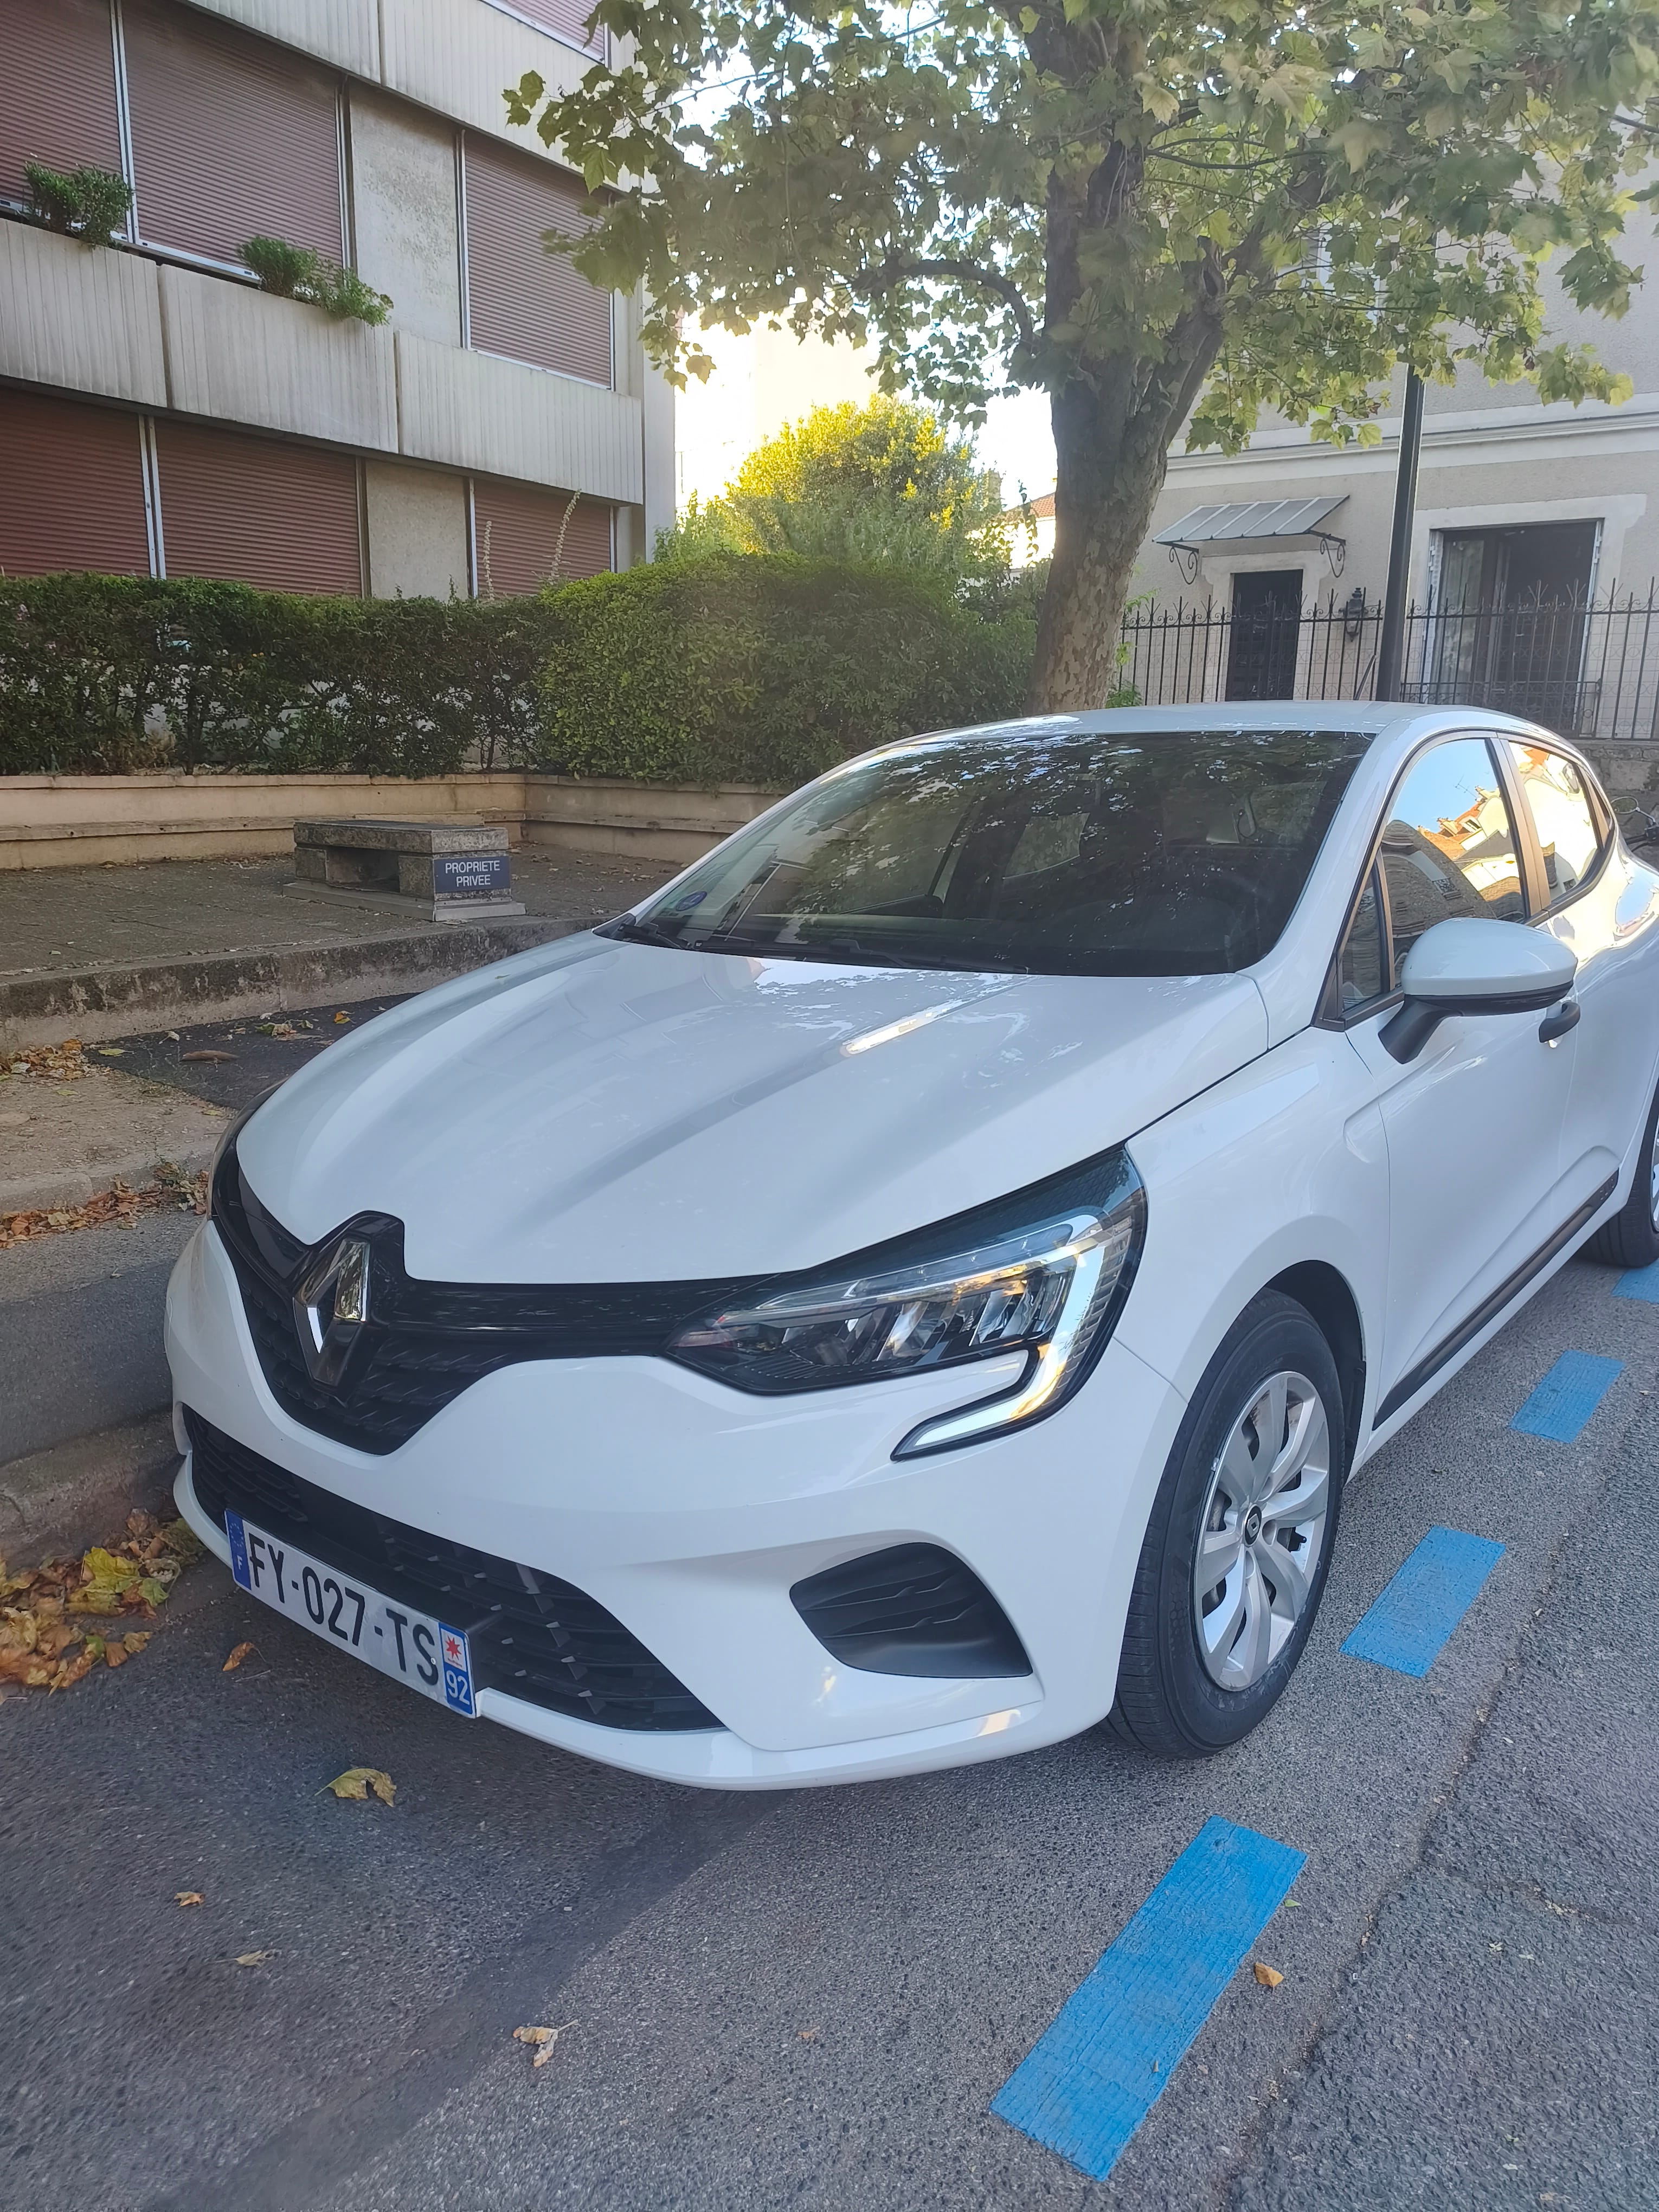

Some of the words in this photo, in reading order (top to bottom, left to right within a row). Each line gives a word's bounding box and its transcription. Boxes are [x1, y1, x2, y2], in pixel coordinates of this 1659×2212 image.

[445, 860, 500, 874] PROPRIETE
[456, 874, 491, 888] PRIVEE
[236, 1554, 243, 1570] F
[248, 1532, 439, 1686] FY-027-TS
[446, 1670, 470, 1705] 92
